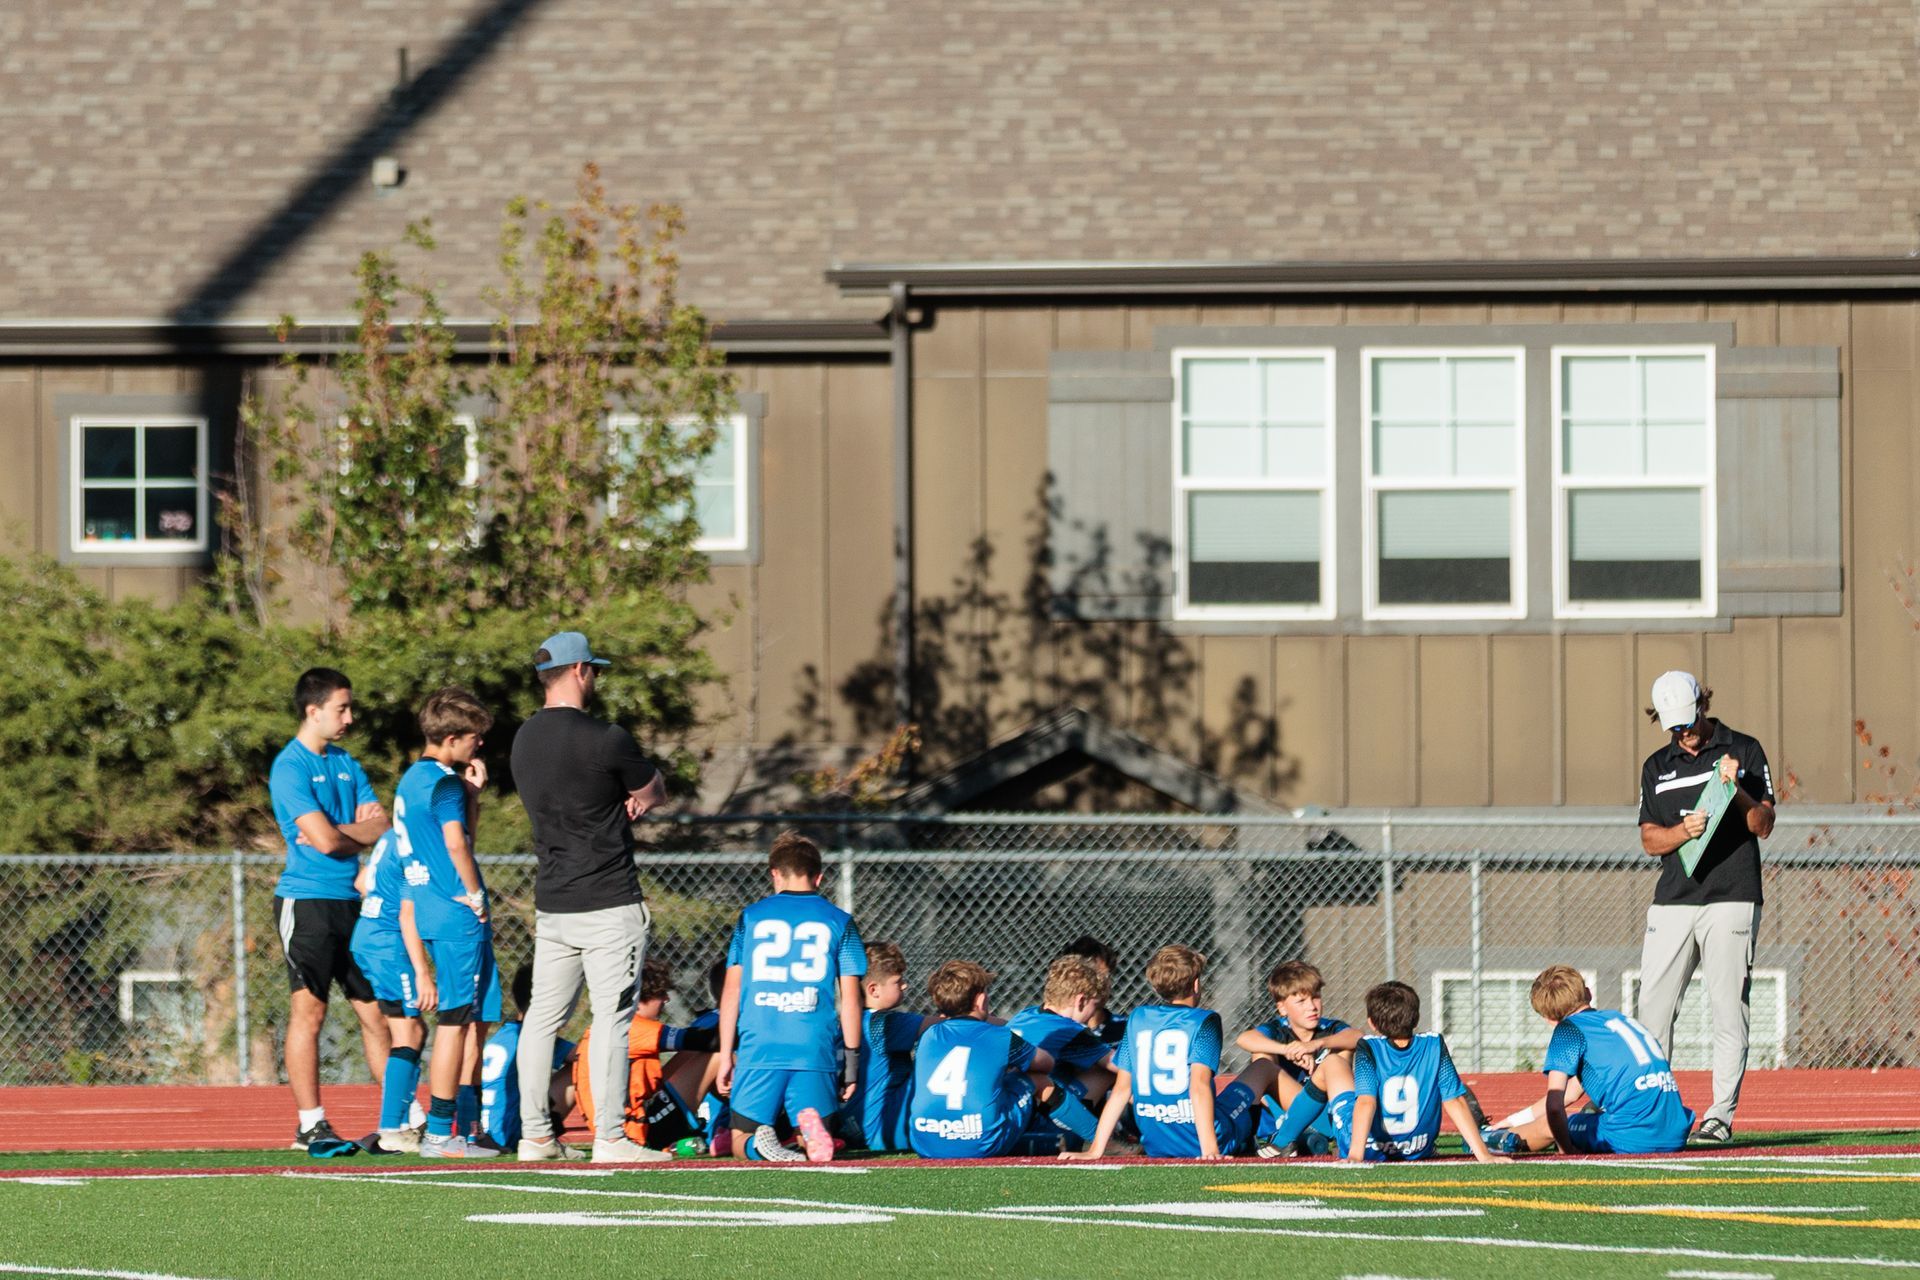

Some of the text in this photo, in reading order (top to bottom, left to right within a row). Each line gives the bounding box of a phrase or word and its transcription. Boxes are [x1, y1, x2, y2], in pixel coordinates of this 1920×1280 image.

[752, 919, 831, 982] 23
[755, 986, 819, 1011] capelli
[926, 1045, 972, 1110] 4
[1136, 1029, 1189, 1096] 19
[915, 1113, 982, 1137] capelli
[1382, 1073, 1419, 1135] 9
[947, 1132, 983, 1140] SPORT
